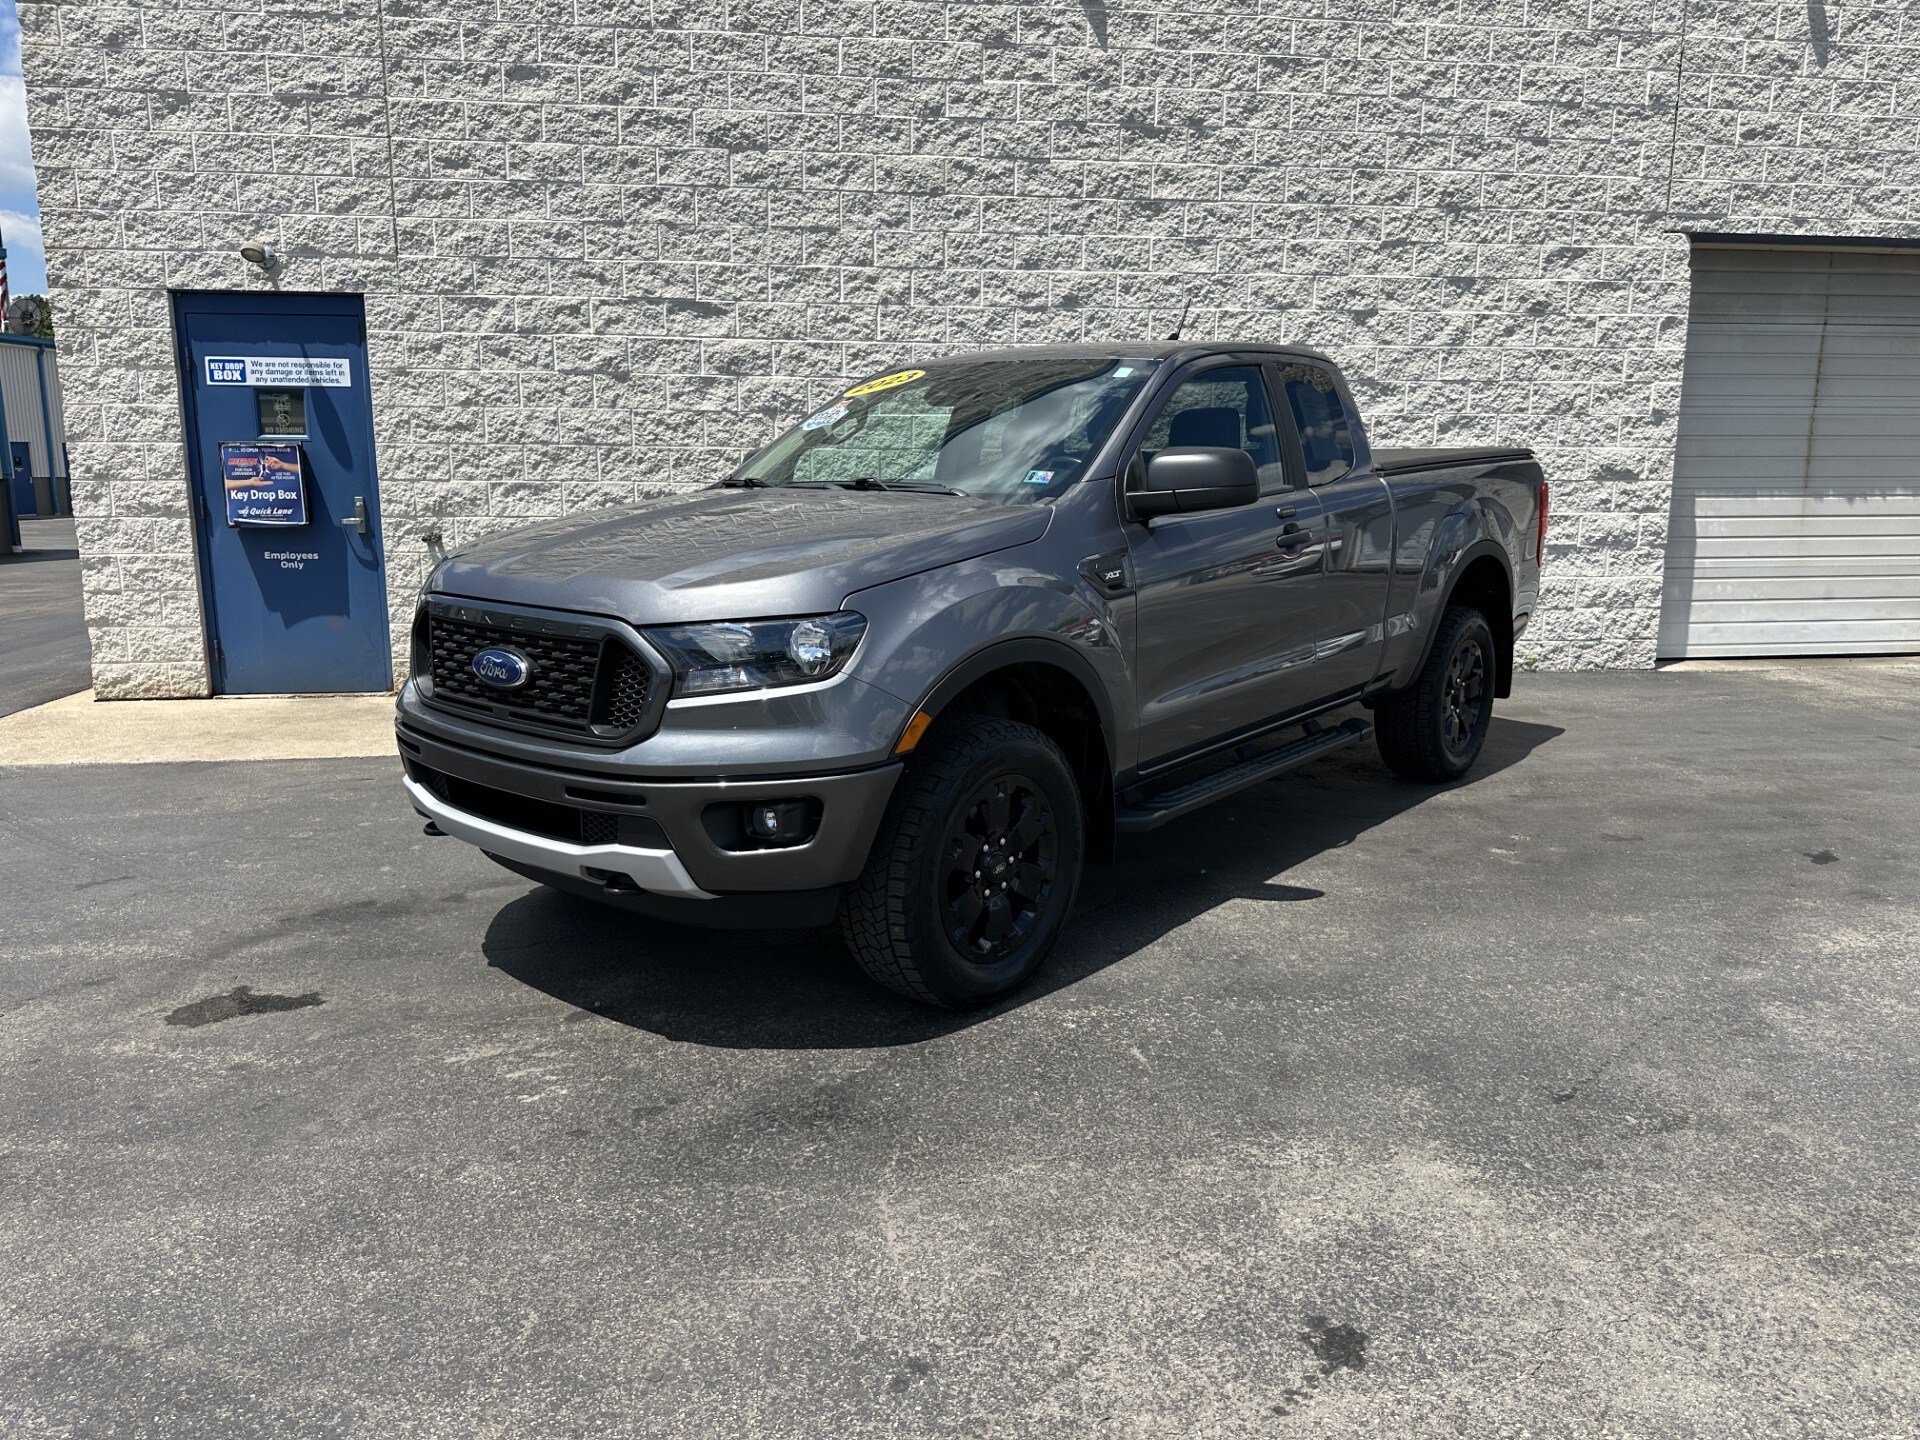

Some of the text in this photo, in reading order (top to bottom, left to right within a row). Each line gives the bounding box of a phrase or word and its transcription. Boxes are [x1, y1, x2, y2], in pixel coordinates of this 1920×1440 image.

[210, 362, 244, 370] KEY DROP
[250, 360, 263, 368] We
[291, 361, 331, 369] responsible
[213, 370, 242, 381] BOX
[265, 368, 293, 377] damage
[325, 368, 337, 376] left
[269, 376, 310, 384] unattended
[230, 489, 298, 502] Key Drop Box
[250, 507, 293, 515] Quick Lane
[264, 551, 319, 561] Employees
[280, 560, 304, 570] Only
[1104, 569, 1122, 580] XLT
[480, 655, 510, 679] Ford
